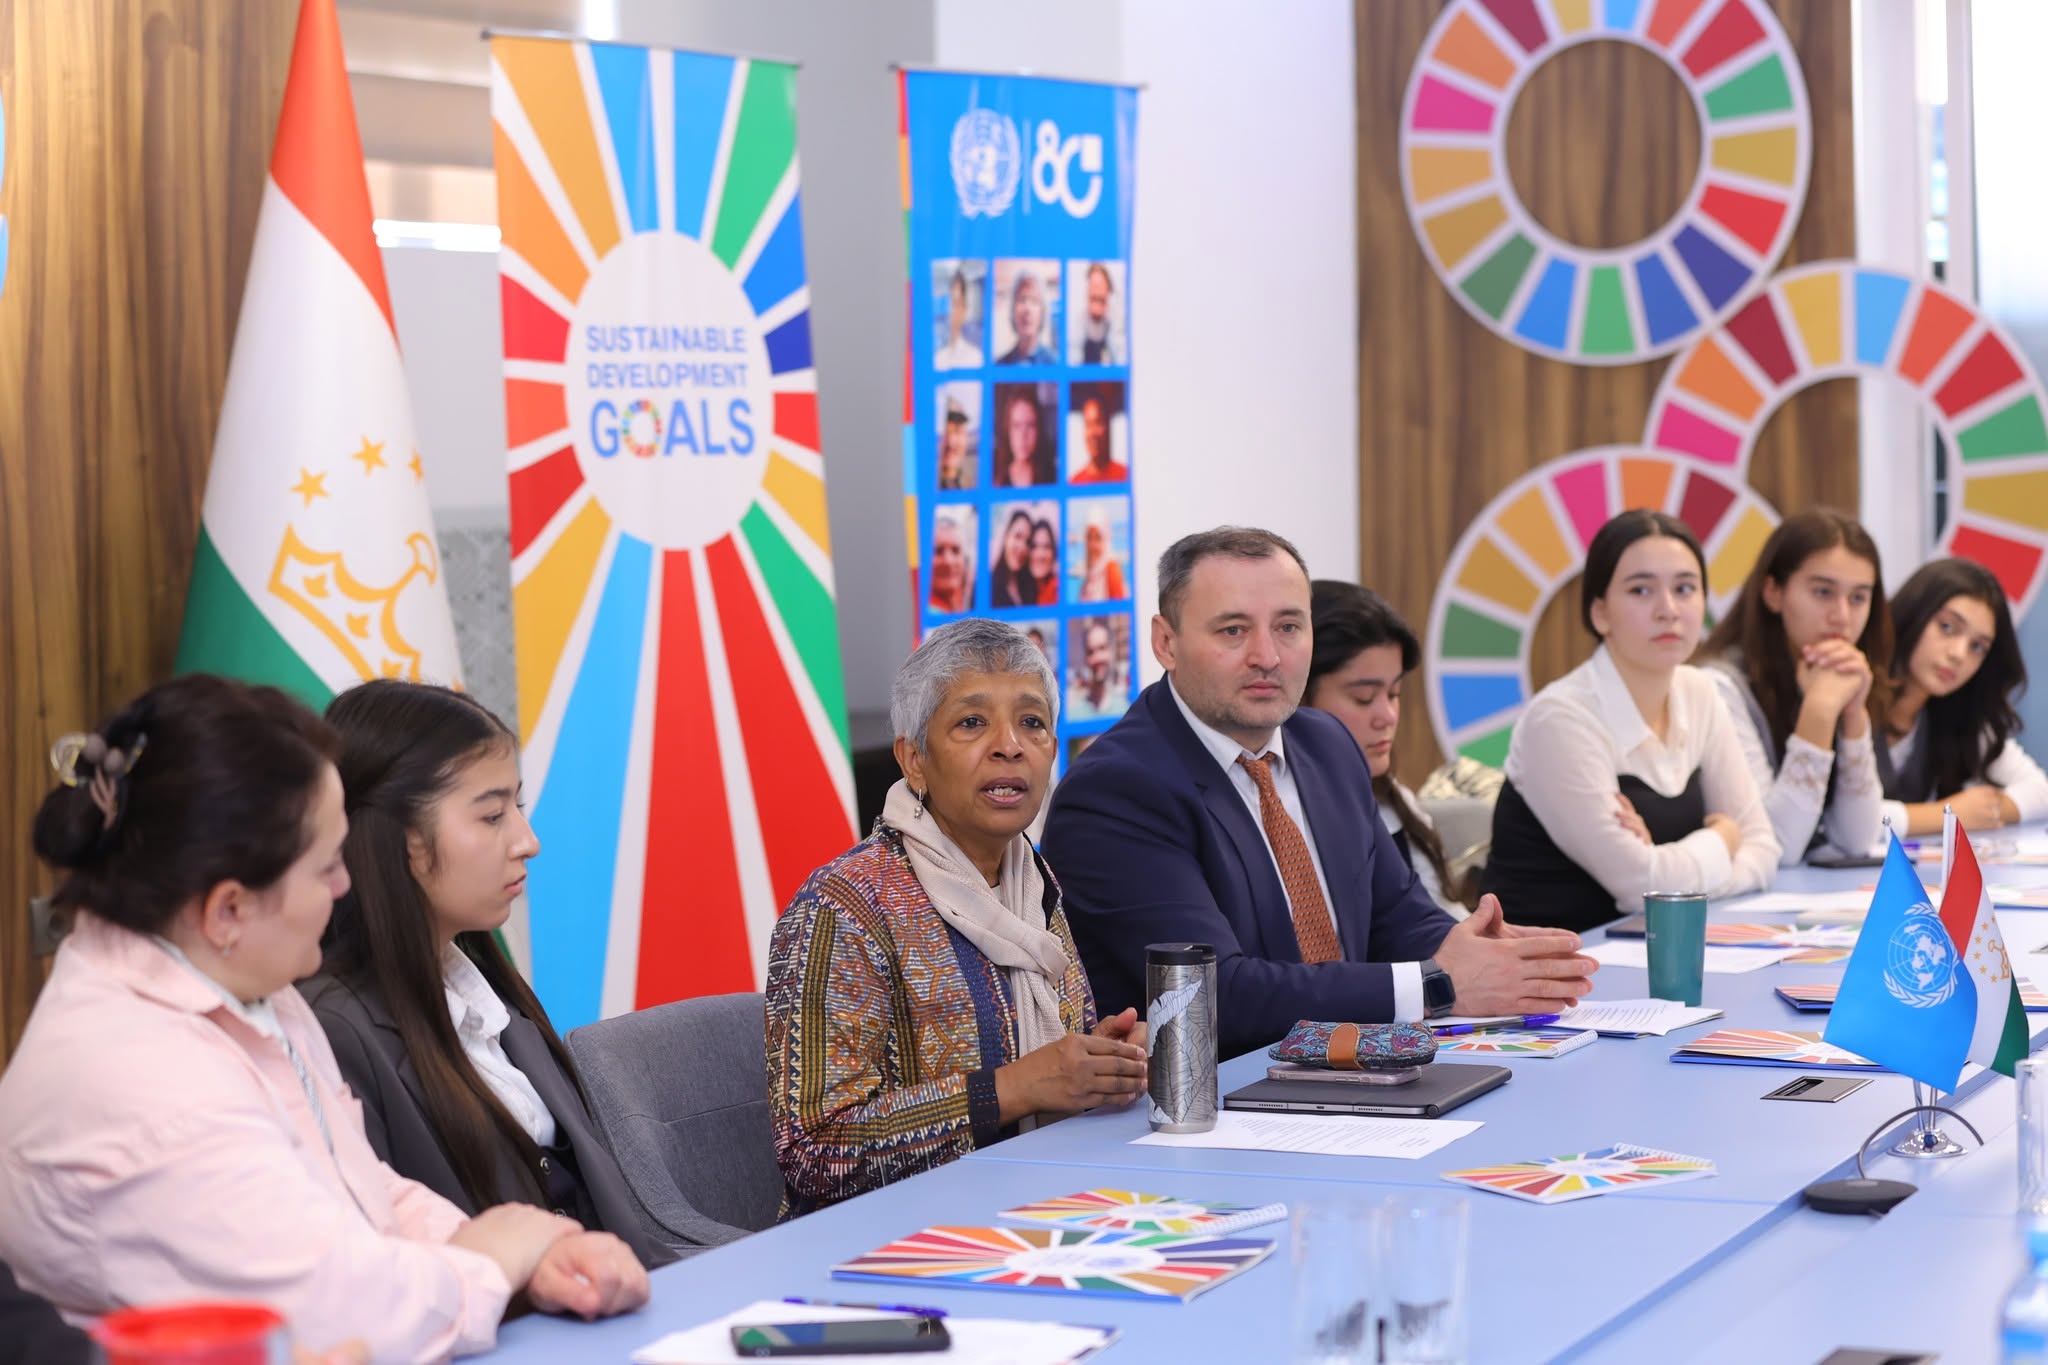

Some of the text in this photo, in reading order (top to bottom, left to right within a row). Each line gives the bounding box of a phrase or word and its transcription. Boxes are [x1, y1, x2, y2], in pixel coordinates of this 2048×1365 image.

[586, 325, 748, 352] SUSTAINABLE
[587, 362, 748, 389] DEVELOPMENT
[590, 398, 756, 458] GOALS
